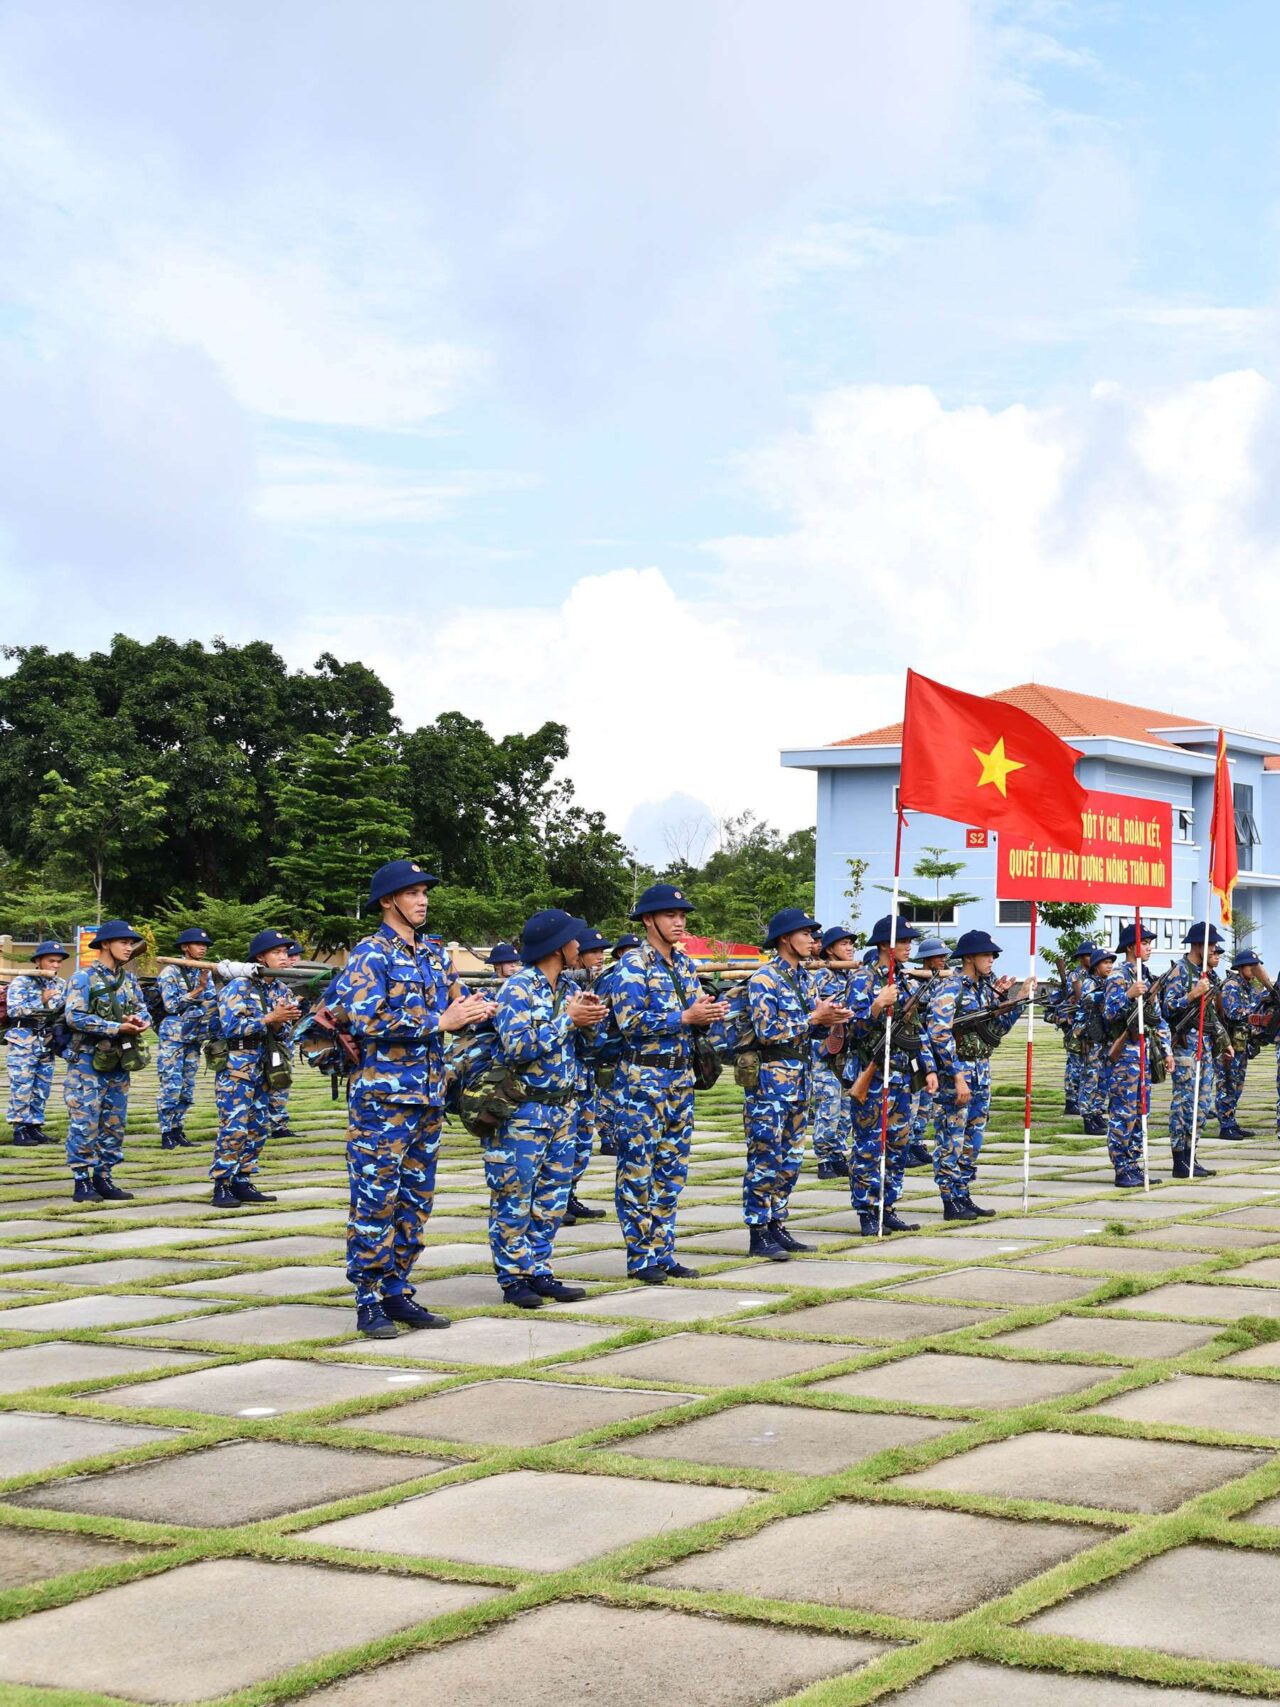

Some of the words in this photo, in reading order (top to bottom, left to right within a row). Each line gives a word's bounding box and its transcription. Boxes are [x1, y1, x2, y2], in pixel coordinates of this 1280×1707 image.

[969, 832, 985, 844] S2
[1124, 815, 1145, 846] ĐOÀN
[1009, 842, 1039, 879] QUYẾT
[1041, 847, 1060, 879] TÂM
[1062, 851, 1080, 881] XÂY
[1081, 854, 1104, 887] DỰNG
[1106, 853, 1128, 885] NÔNG
[1129, 856, 1150, 887] THÔN
[1151, 858, 1165, 888] MỚI
